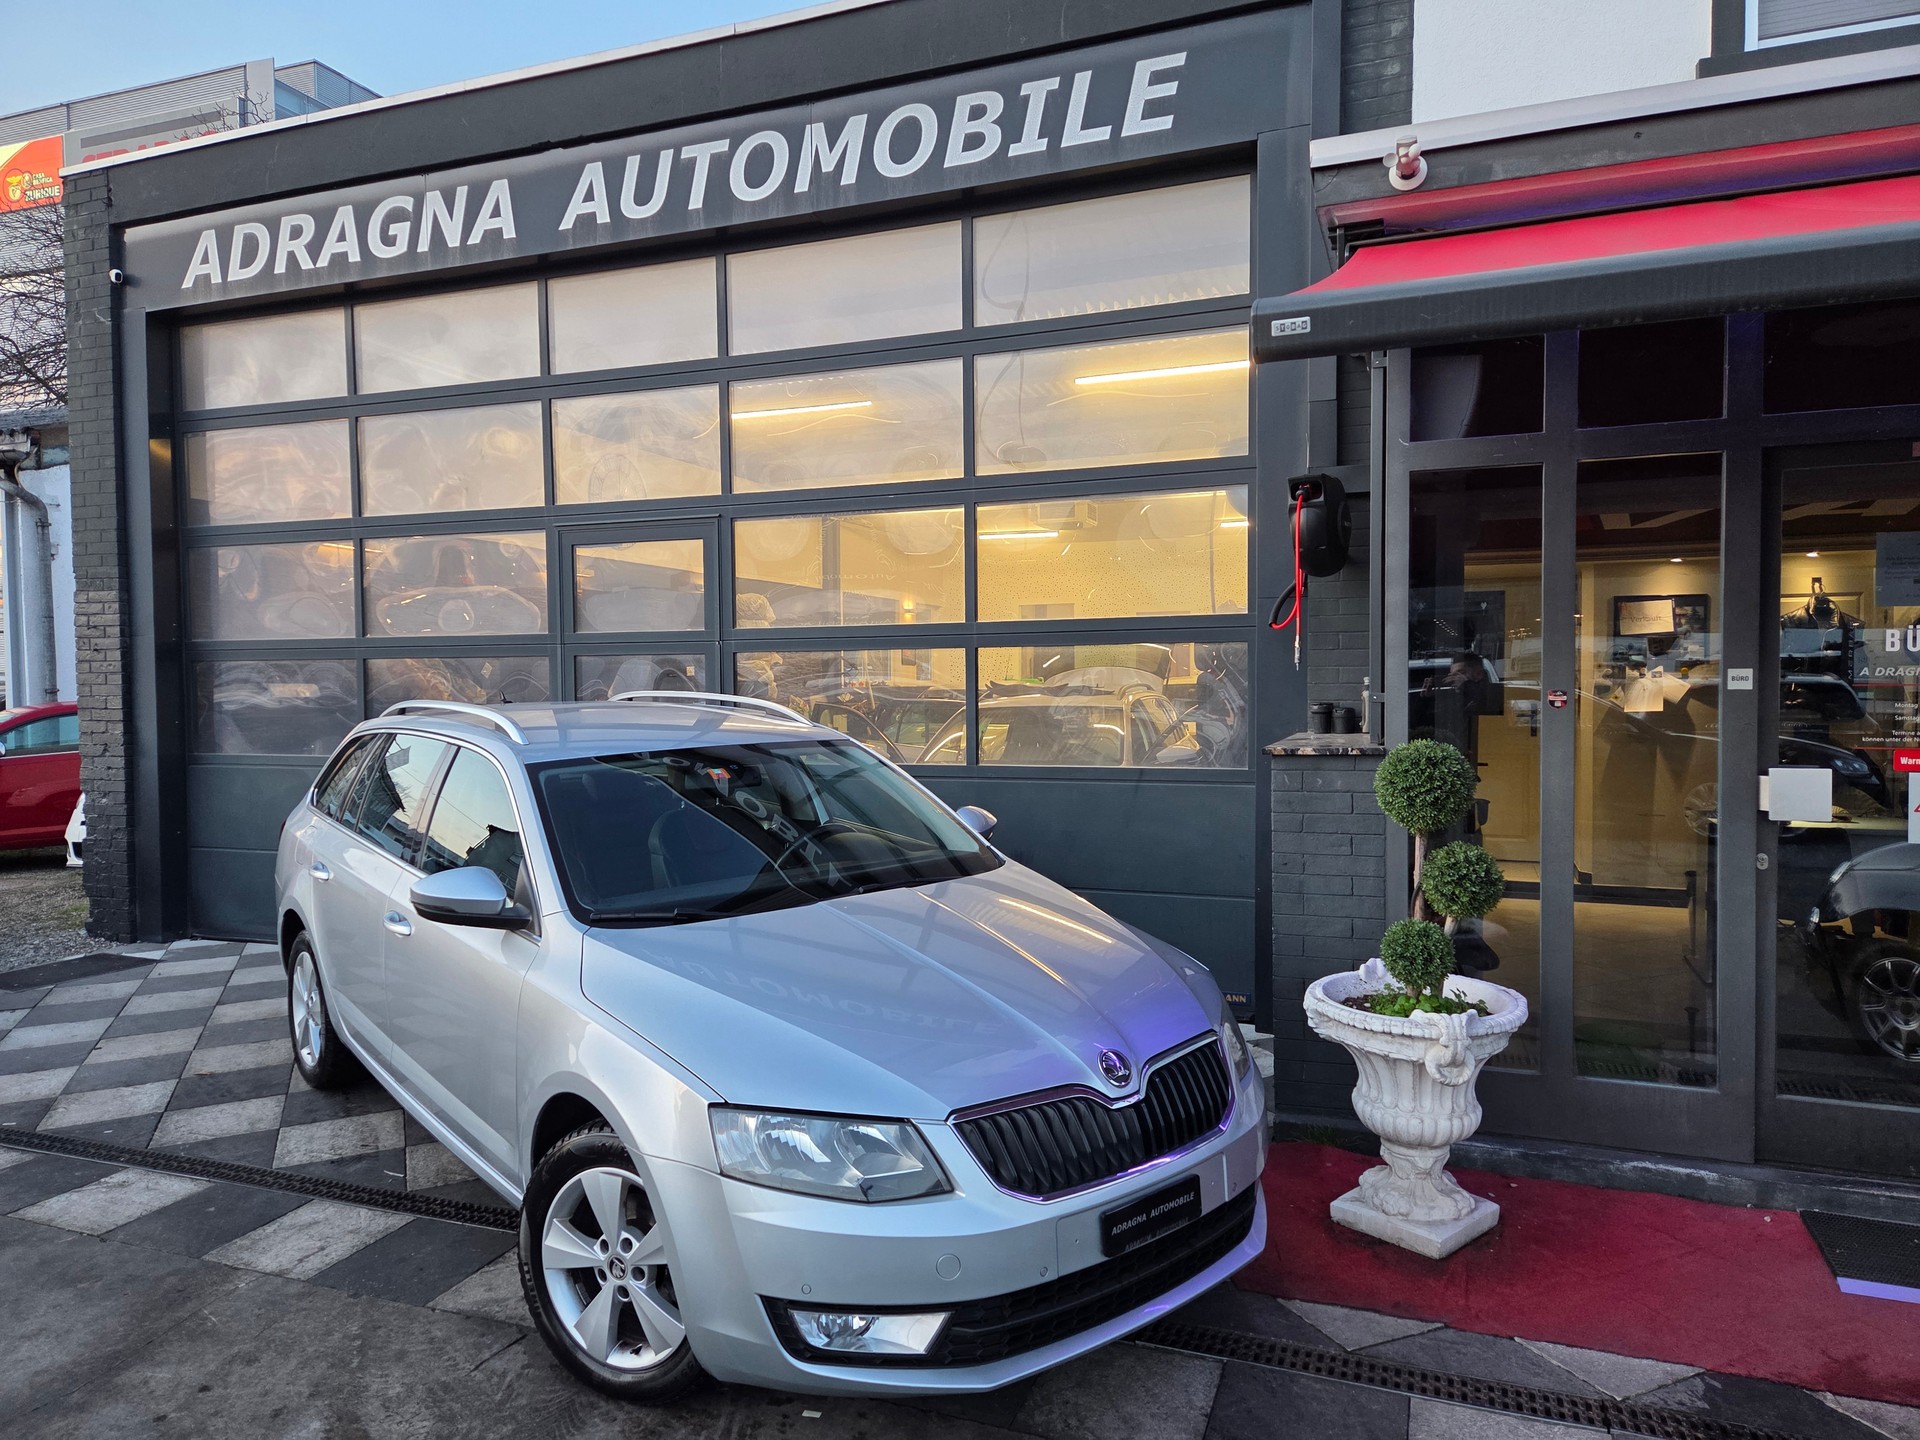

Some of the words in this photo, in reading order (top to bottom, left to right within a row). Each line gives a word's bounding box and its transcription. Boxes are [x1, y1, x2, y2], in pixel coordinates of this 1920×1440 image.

[181, 179, 517, 290] ADRAGNA
[558, 51, 1188, 231] AUTOMOBILE
[25, 185, 60, 202] ZURIQUE
[1274, 321, 1308, 333] STOBAG
[1894, 714, 1920, 722] Samstag
[1111, 1213, 1147, 1236] ADRAGNA
[1150, 1191, 1195, 1218] AUTOMOBILE
